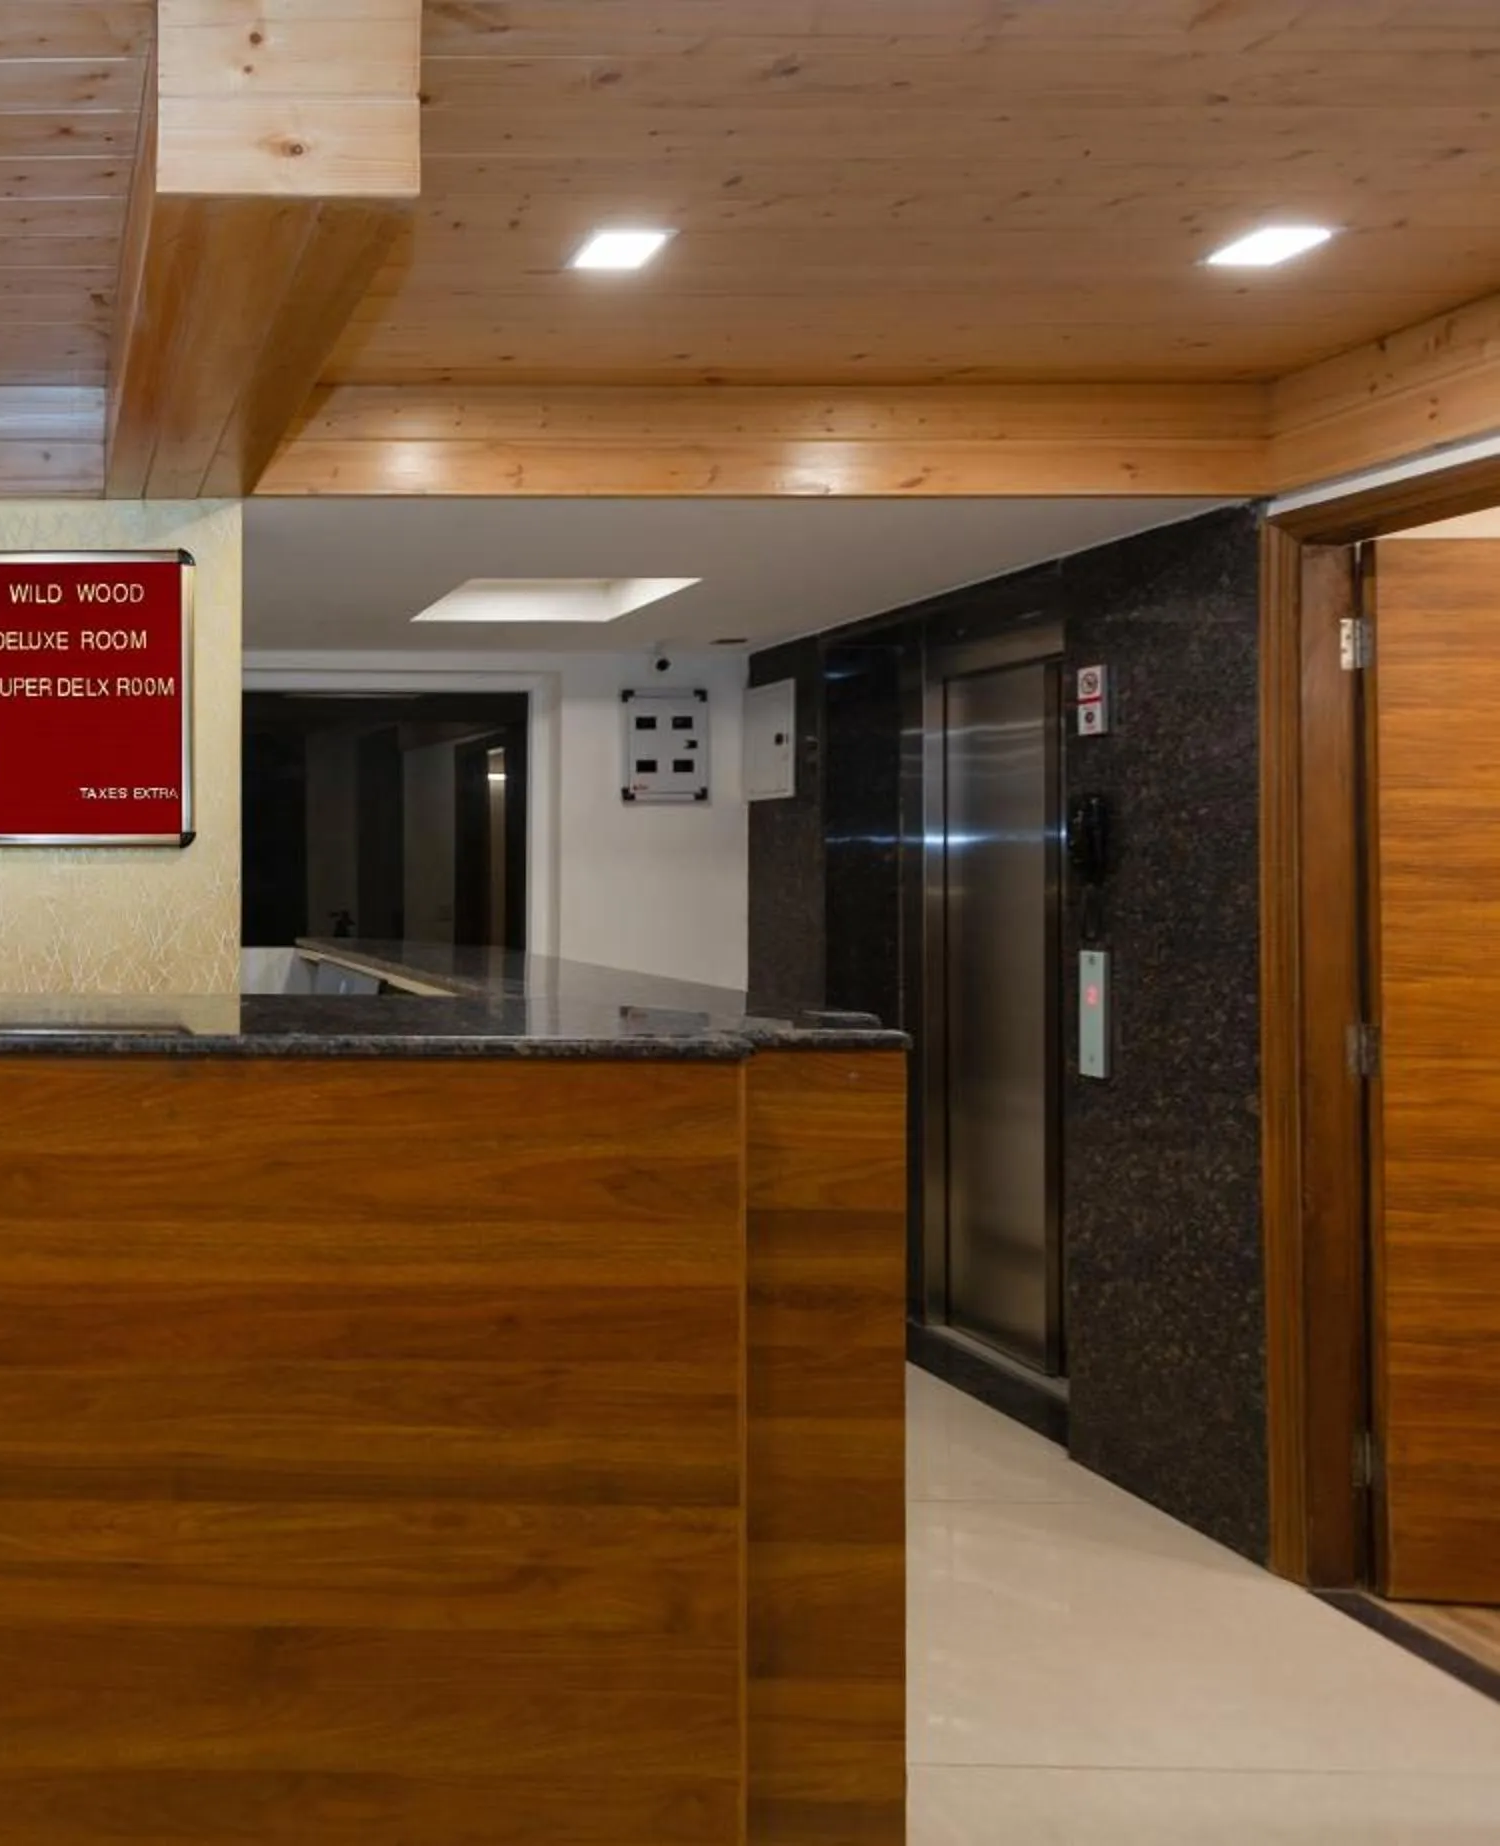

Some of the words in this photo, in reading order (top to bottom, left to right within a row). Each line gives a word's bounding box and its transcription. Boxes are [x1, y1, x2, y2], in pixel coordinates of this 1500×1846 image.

[9, 583, 63, 604] WILD
[76, 583, 145, 603] WOOD
[80, 630, 147, 650] ROOM
[57, 677, 110, 697] DELX
[79, 787, 128, 800] TAXES
[133, 787, 179, 800] EXTRA
